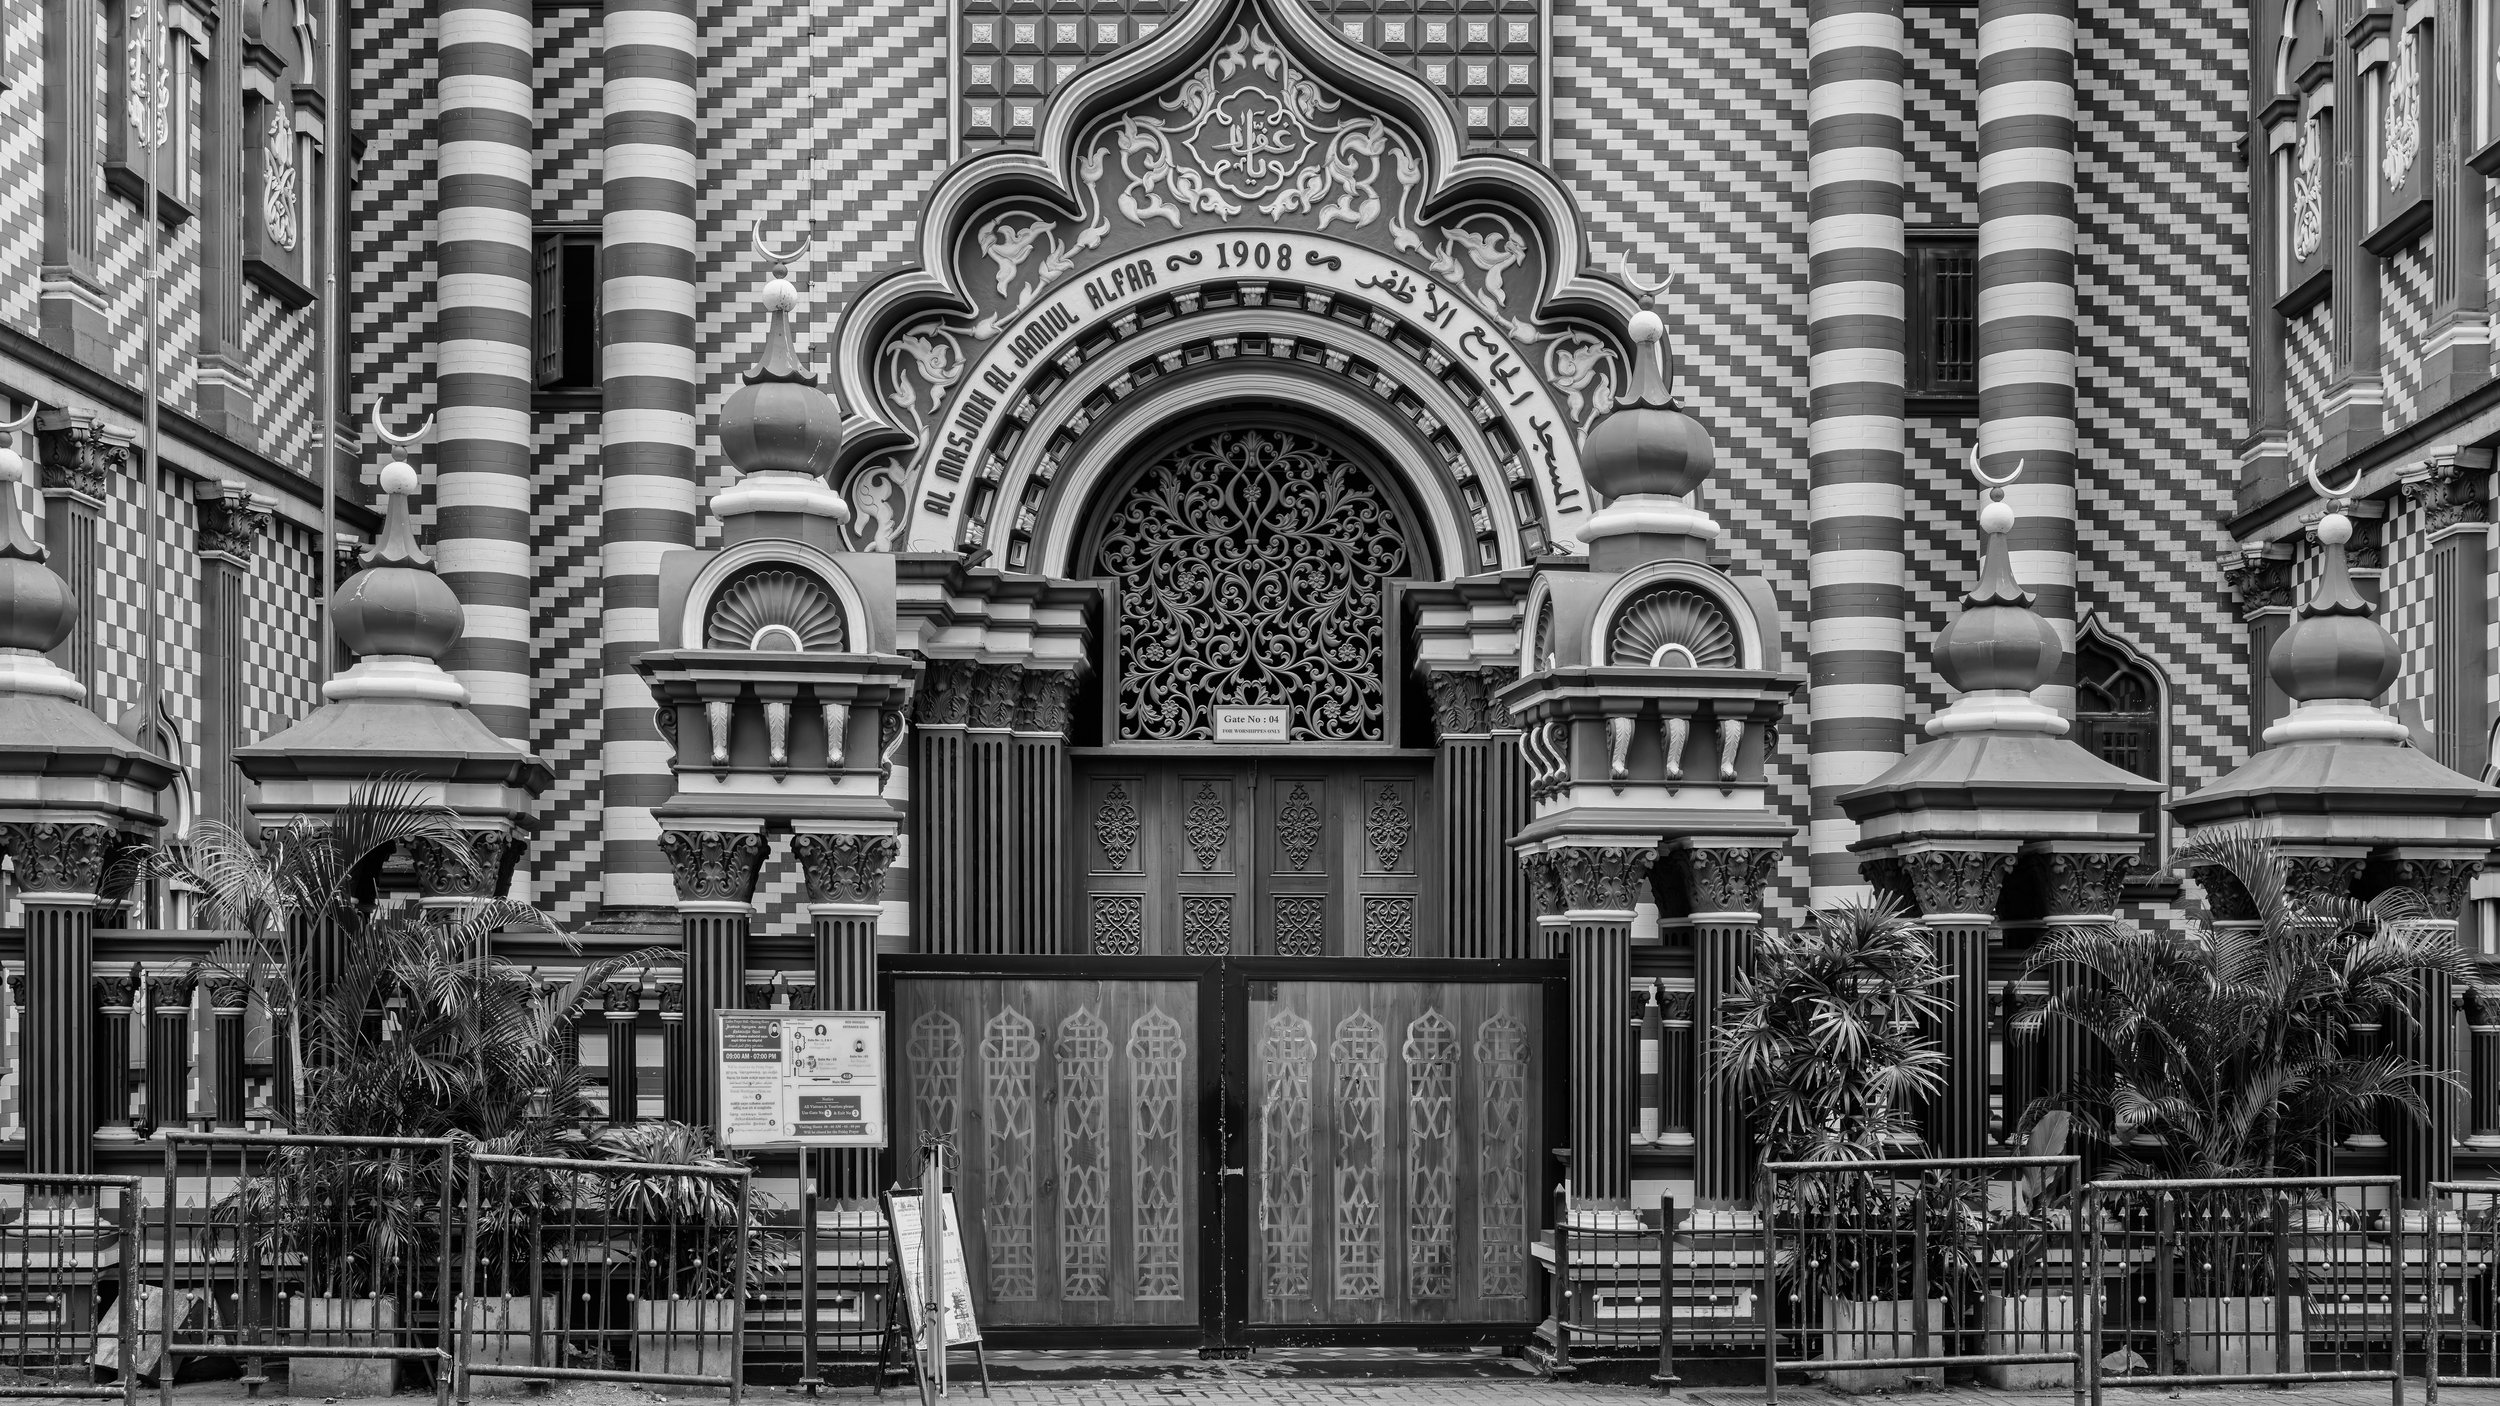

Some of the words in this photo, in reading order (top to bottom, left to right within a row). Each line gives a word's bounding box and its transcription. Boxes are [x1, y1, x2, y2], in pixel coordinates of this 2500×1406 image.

[1216, 240, 1292, 271] 1908
[1084, 259, 1157, 310] ALFAR
[1007, 302, 1080, 368] JAMIUL
[983, 364, 1017, 394] AL
[1459, 326, 1534, 406] الجامع
[935, 389, 997, 483] MASJIDH
[1529, 415, 1583, 514] المسجد
[924, 491, 956, 517] AL
[1224, 715, 1245, 723] Gate
